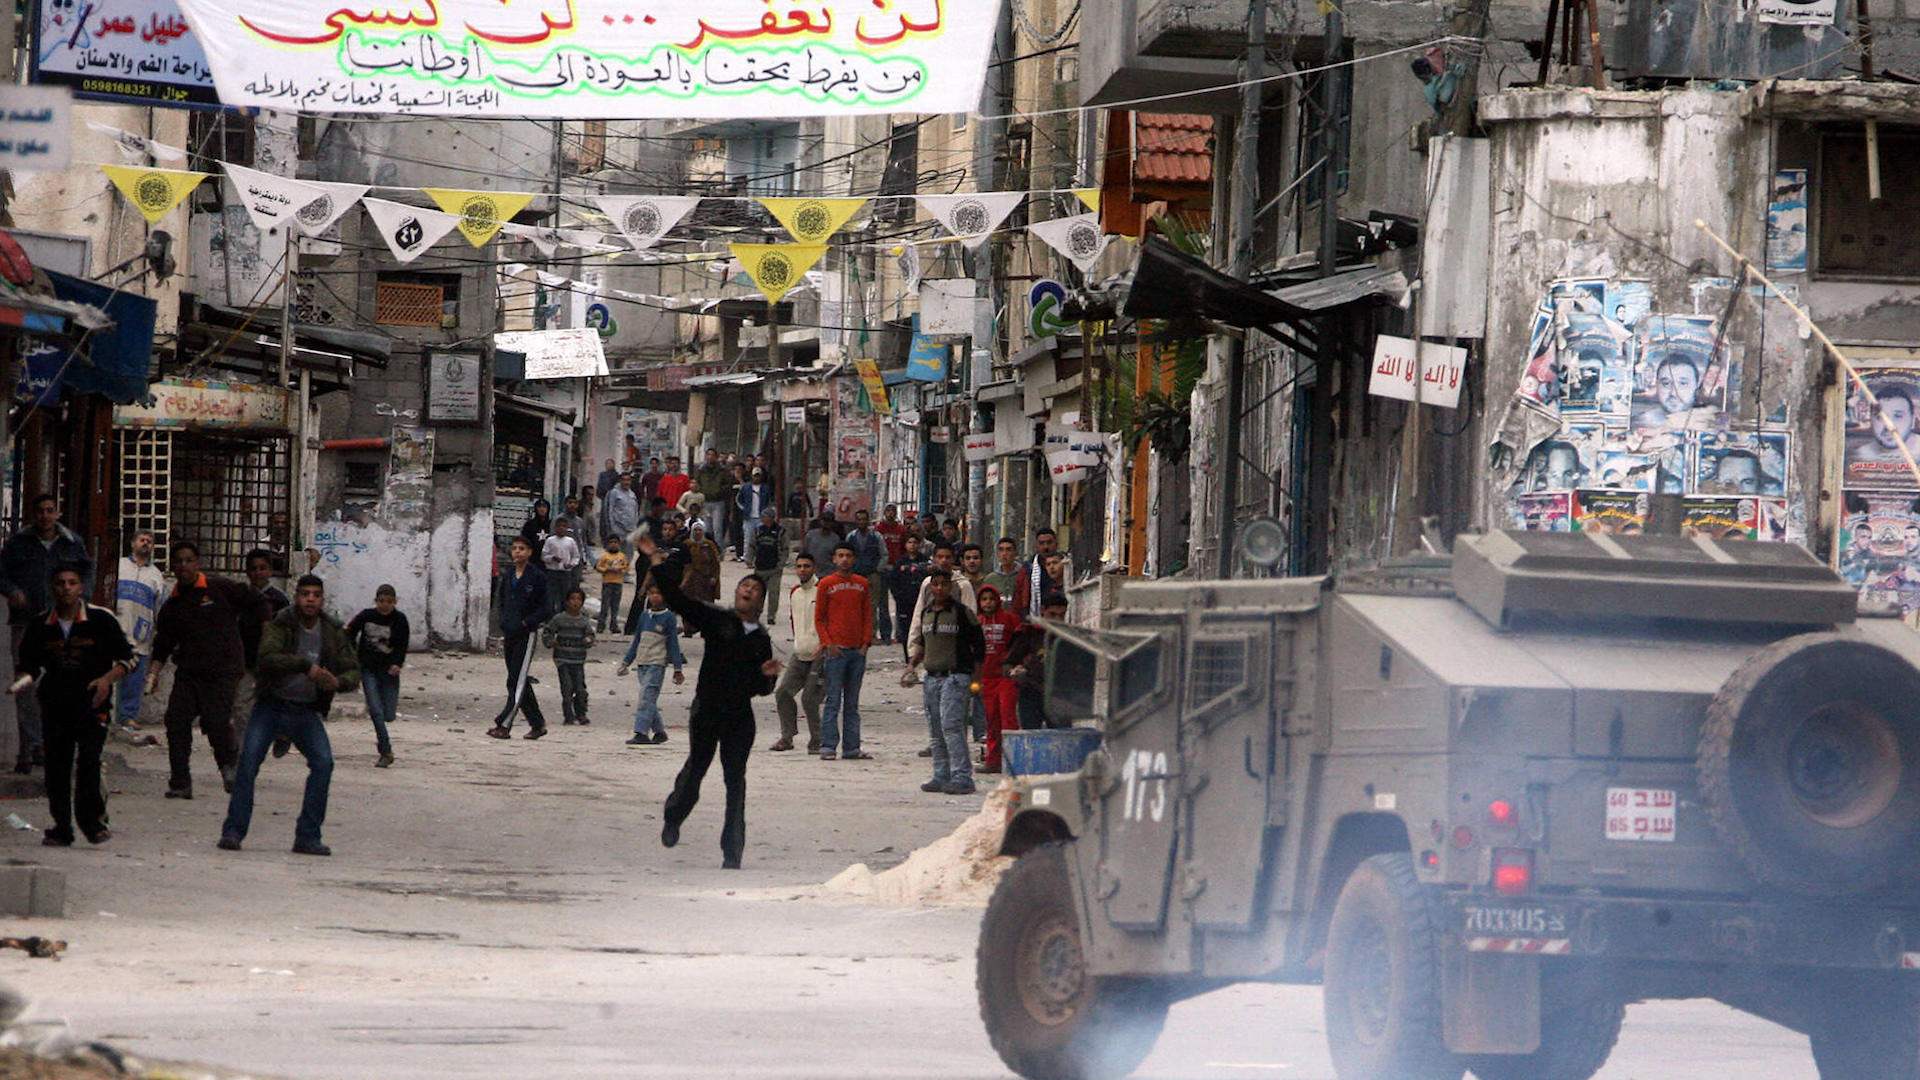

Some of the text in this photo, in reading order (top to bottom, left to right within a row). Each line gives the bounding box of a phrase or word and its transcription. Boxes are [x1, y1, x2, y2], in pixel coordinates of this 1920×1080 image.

[93, 12, 190, 45] خليل عمر
[137, 54, 168, 76] الفم
[584, 49, 692, 91] بالعودة
[800, 48, 859, 94] يفرط
[161, 86, 190, 100] جوال
[866, 68, 922, 94] من
[301, 78, 331, 109] مخيم
[332, 82, 384, 105] لخدمات
[389, 84, 451, 112] الشعبية
[454, 89, 500, 111] اللجنة
[1377, 354, 1402, 377] الله
[1449, 366, 1459, 388] لا
